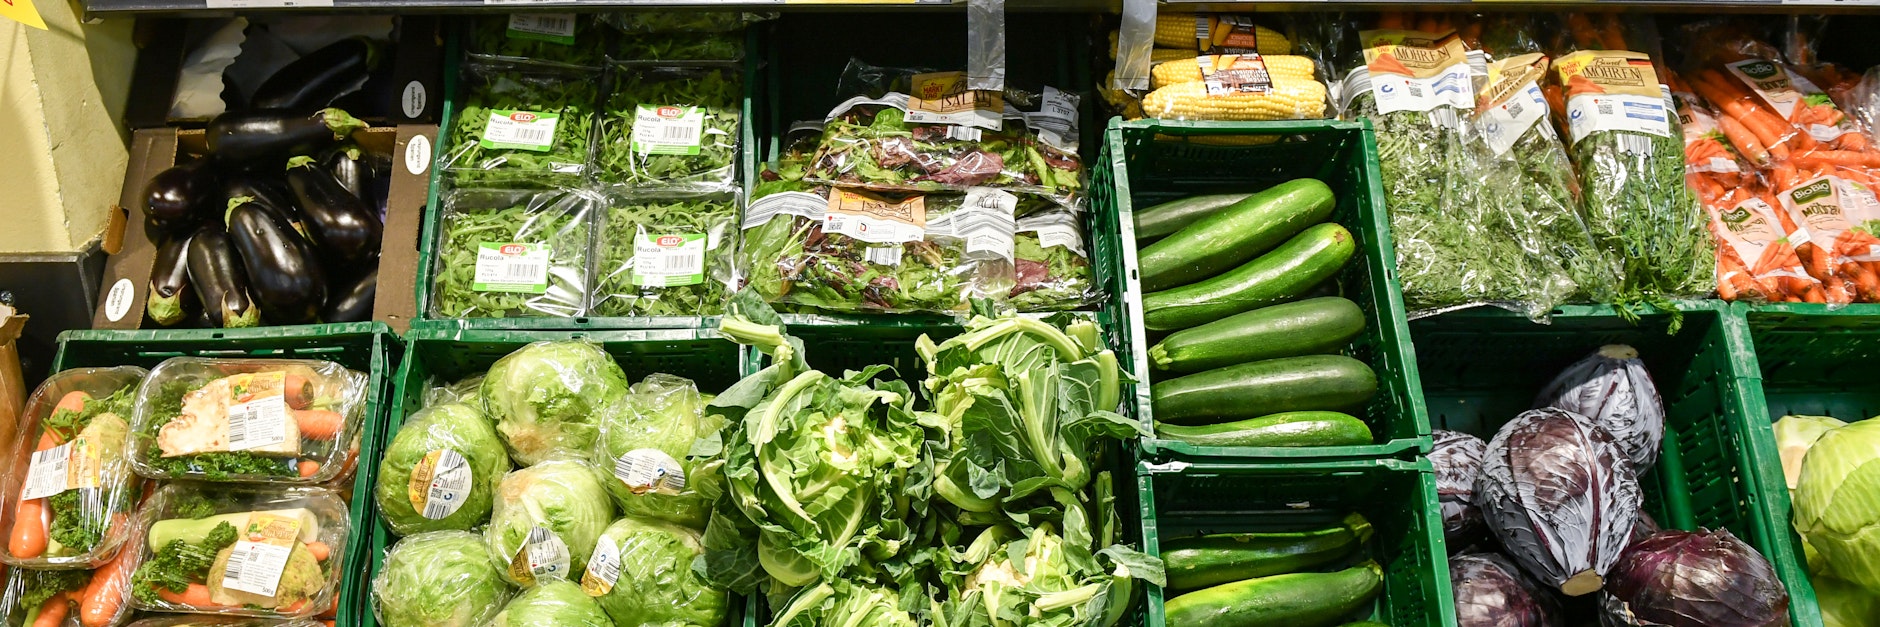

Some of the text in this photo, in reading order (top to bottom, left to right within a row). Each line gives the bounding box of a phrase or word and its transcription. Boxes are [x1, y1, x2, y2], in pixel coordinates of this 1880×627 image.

[661, 108, 677, 116] ELO
[491, 118, 514, 126] Rucola
[661, 237, 678, 245] ELO
[504, 246, 521, 254] ELO
